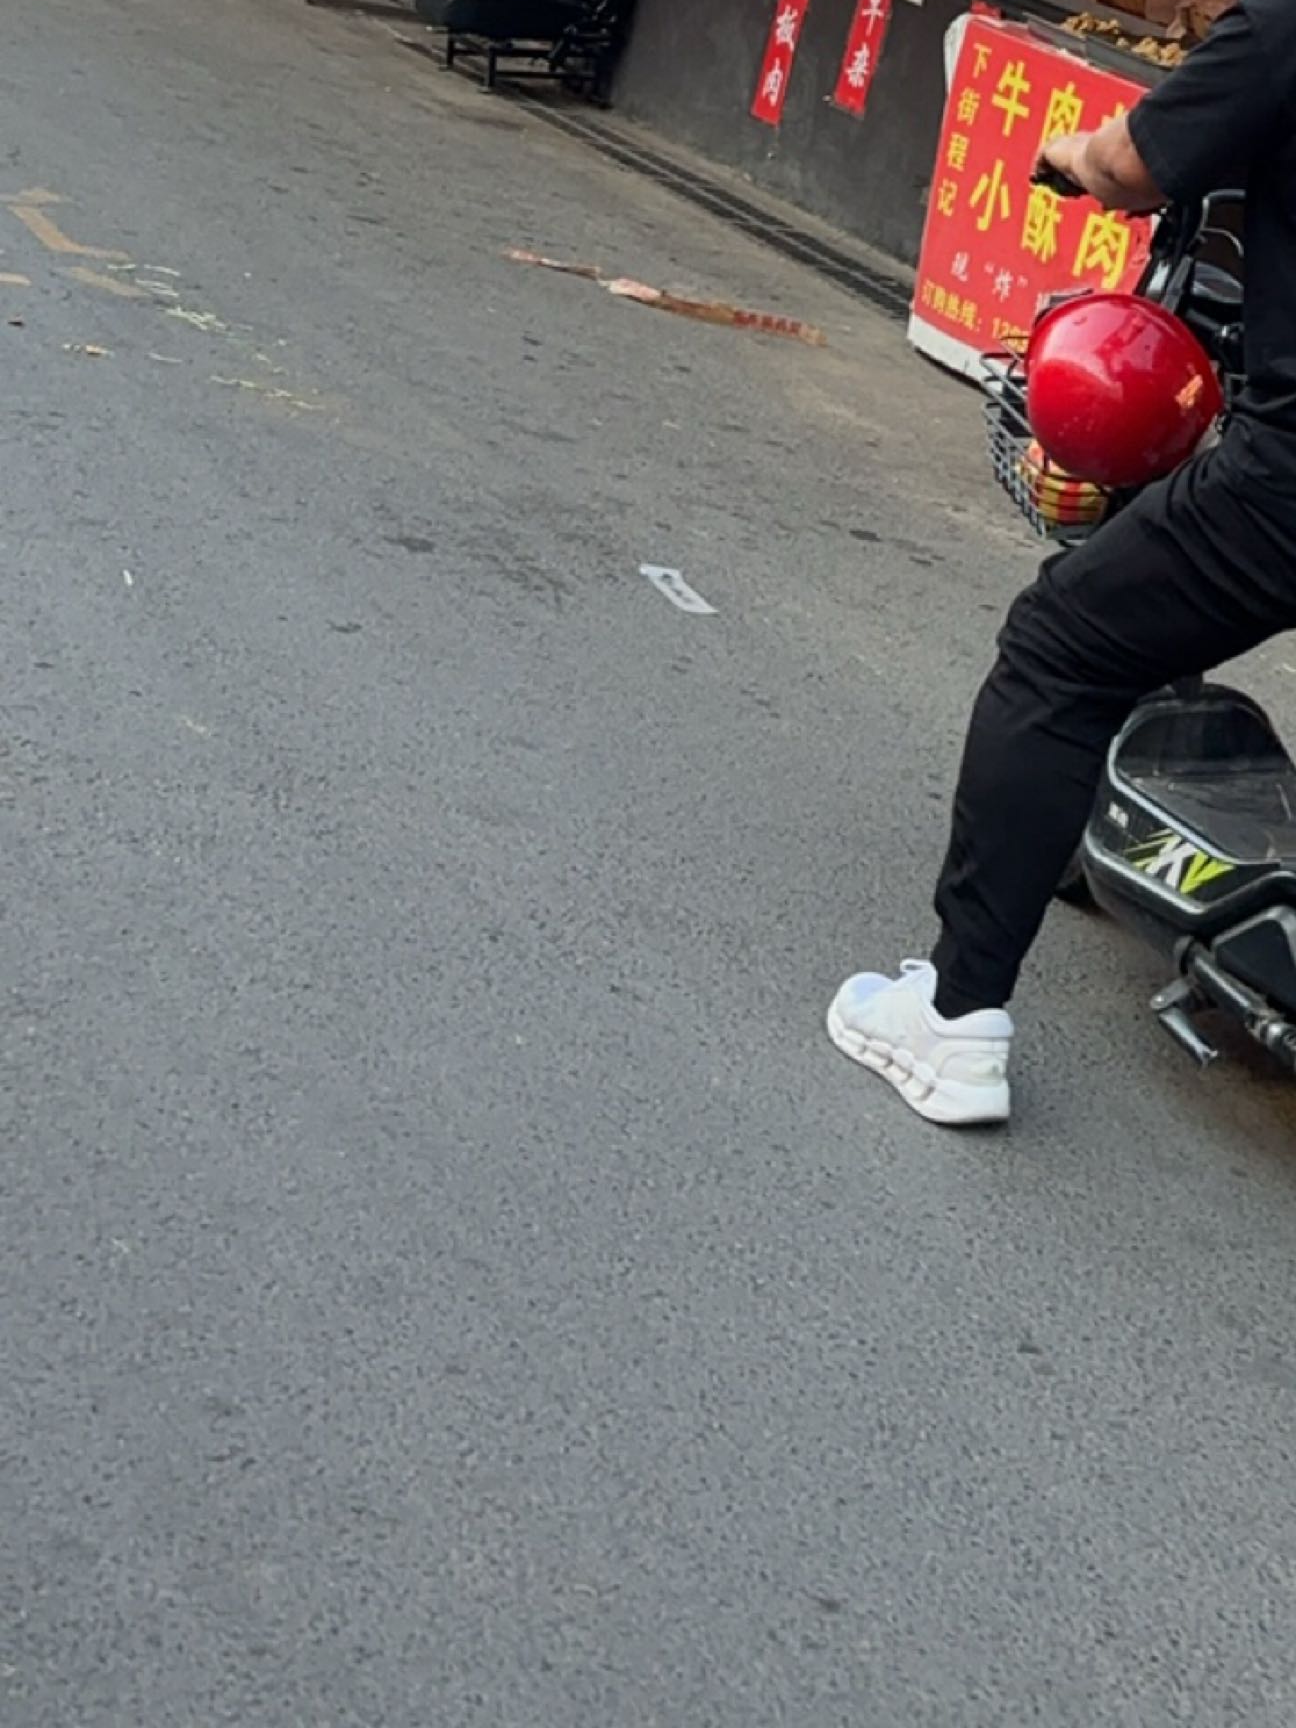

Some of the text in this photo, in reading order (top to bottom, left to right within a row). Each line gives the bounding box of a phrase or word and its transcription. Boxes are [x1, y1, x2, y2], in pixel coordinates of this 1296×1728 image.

[937, 42, 992, 217] 下街程记
[969, 159, 1130, 290] 小酥肉
